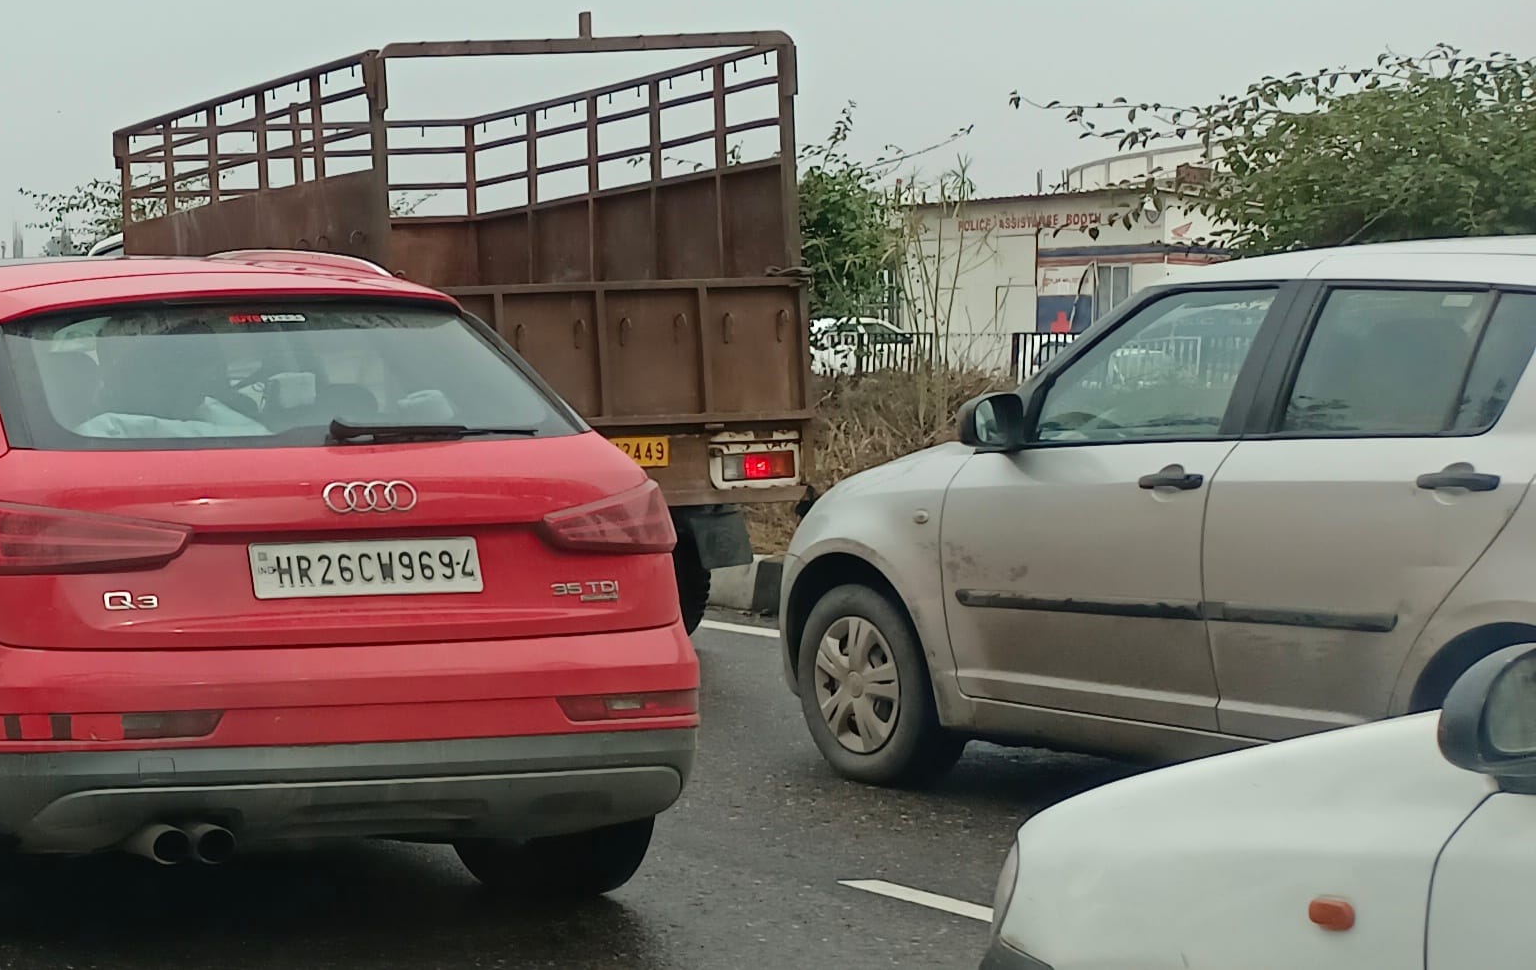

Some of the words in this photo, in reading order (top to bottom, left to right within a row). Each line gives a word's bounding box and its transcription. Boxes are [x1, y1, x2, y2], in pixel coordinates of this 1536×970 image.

[958, 218, 991, 232] POLICE
[1066, 212, 1101, 227] BOOTH
[550, 582, 583, 596] 35
[585, 580, 619, 594] TDI
[103, 591, 159, 610] Q3
